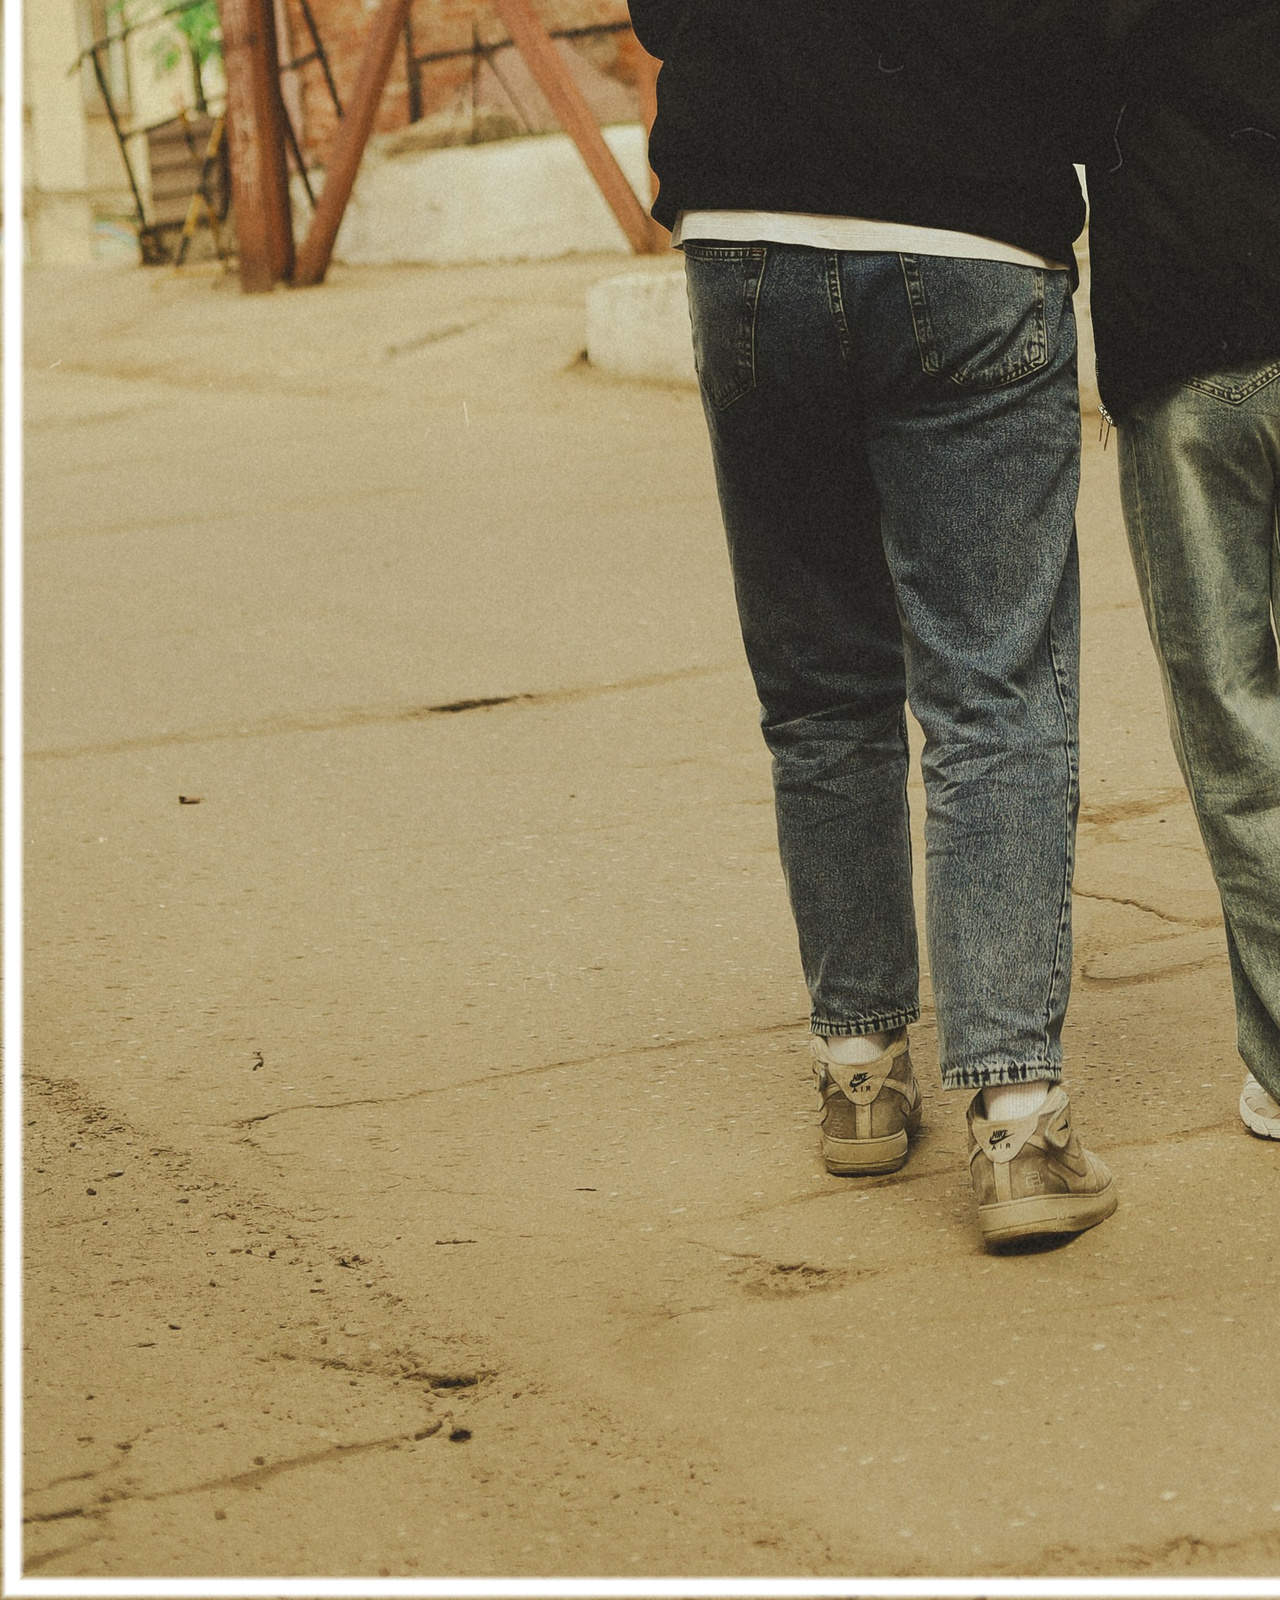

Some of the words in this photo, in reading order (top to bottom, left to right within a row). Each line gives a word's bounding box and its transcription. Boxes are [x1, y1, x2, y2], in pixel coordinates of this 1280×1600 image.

[852, 1071, 868, 1081] NIKE
[851, 1085, 871, 1093] AIR
[991, 1130, 1008, 1139] NIKE
[991, 1142, 1011, 1151] AIR
